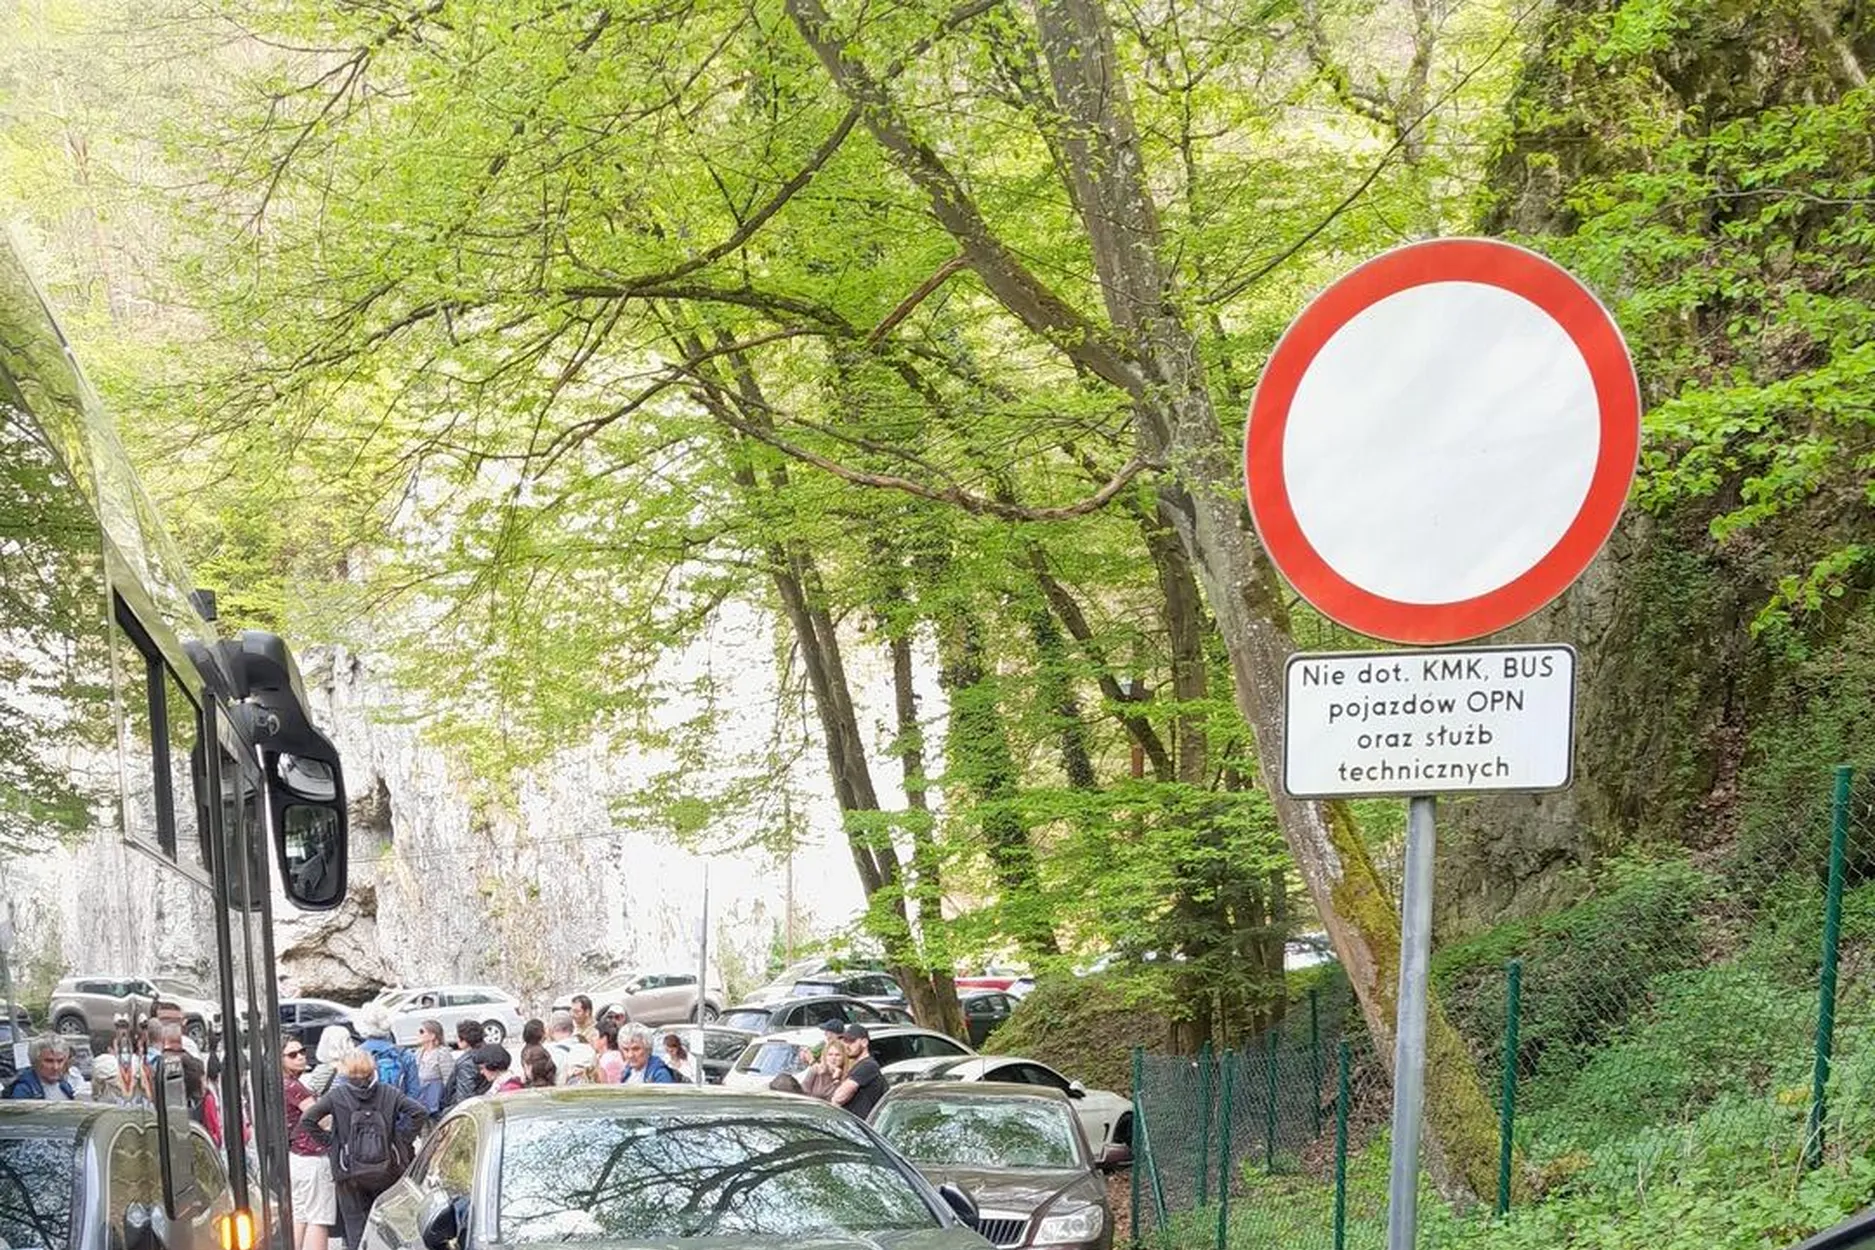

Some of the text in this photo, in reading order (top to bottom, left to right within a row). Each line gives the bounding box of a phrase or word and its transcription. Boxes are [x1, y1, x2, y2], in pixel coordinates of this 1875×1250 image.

[1302, 655, 1554, 686] Nie dot. KMK, BUS
[1328, 690, 1525, 724] pojazdów OPN
[1357, 724, 1493, 749] oraz służb
[1338, 756, 1510, 784] technicznych
